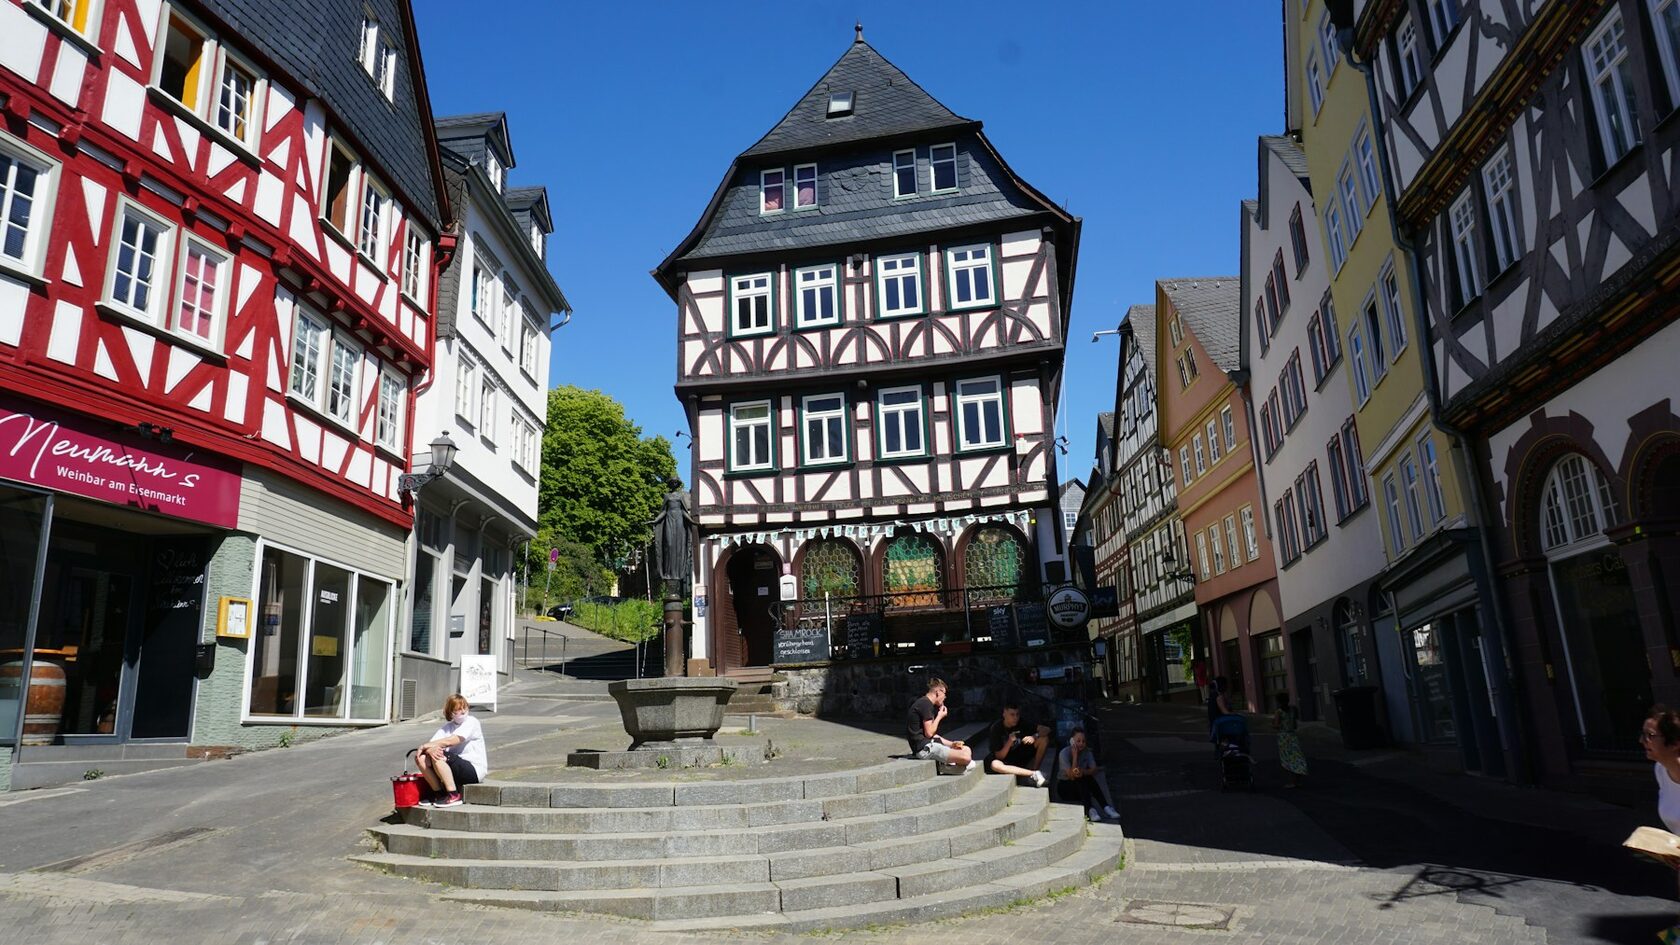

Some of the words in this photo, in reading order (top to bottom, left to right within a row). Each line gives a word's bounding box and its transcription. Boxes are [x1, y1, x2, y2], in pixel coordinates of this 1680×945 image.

[57, 465, 106, 487] Weinbar
[108, 478, 126, 493] am
[129, 482, 187, 506] Eisenmarkt
